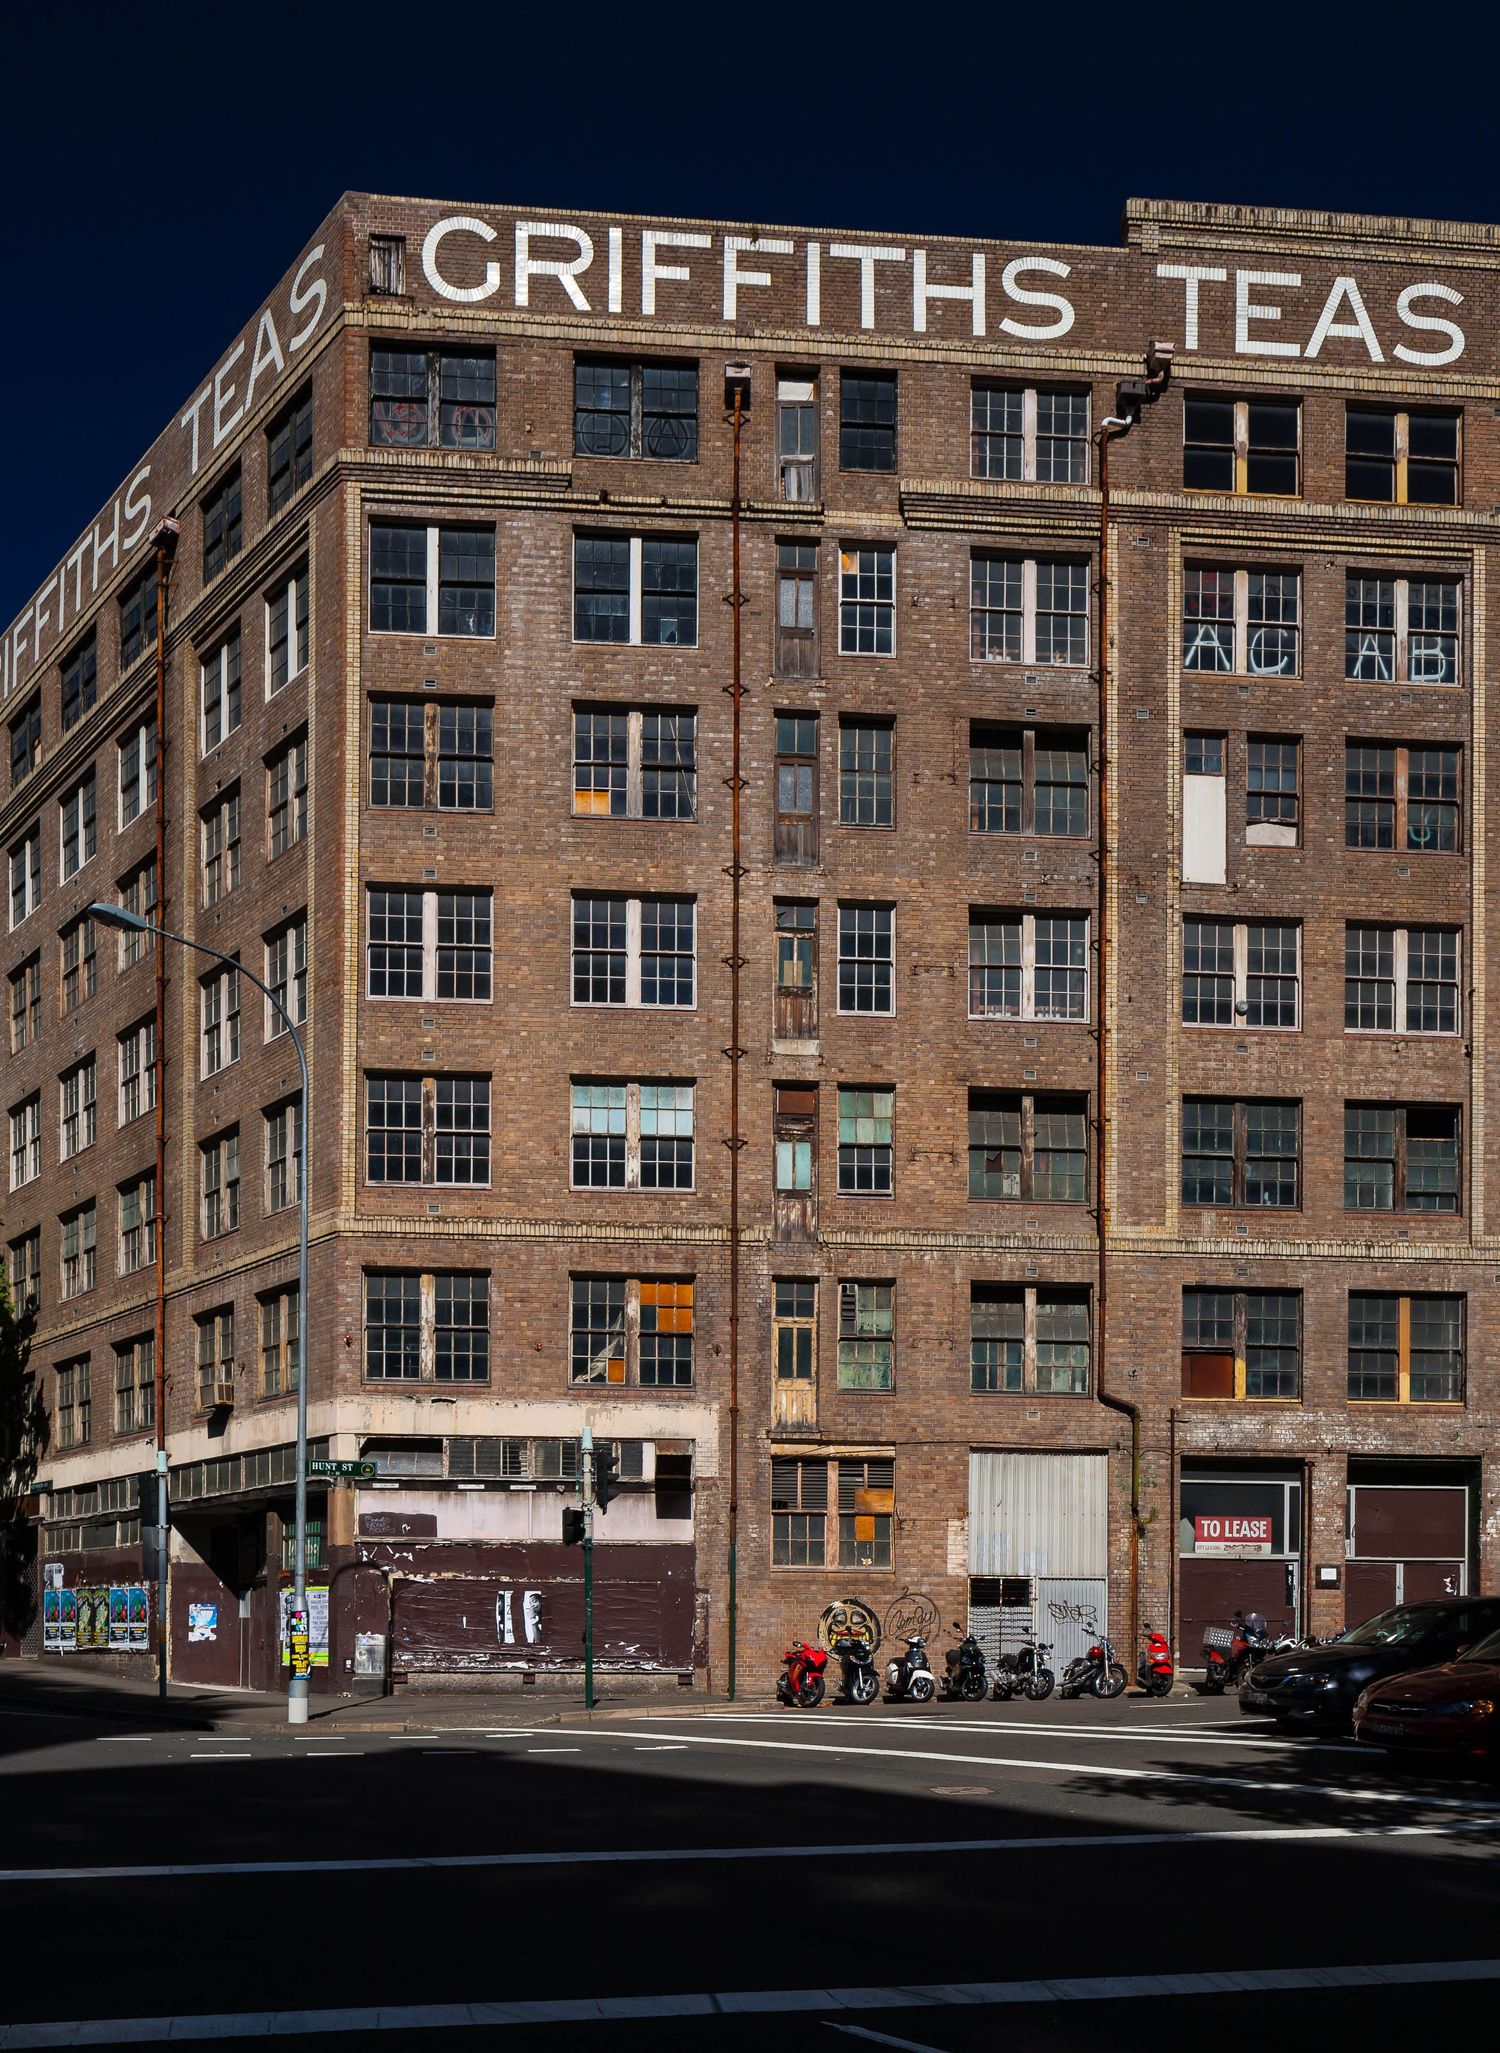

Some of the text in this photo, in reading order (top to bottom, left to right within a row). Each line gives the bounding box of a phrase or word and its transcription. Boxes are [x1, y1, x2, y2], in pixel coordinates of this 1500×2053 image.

[422, 215, 1465, 367] GRIFFITHS TEAS
[0, 243, 327, 704] IFFITHS TEAS
[312, 1462, 354, 1471] HUNT ST
[1201, 1520, 1267, 1538] TO LEASE
